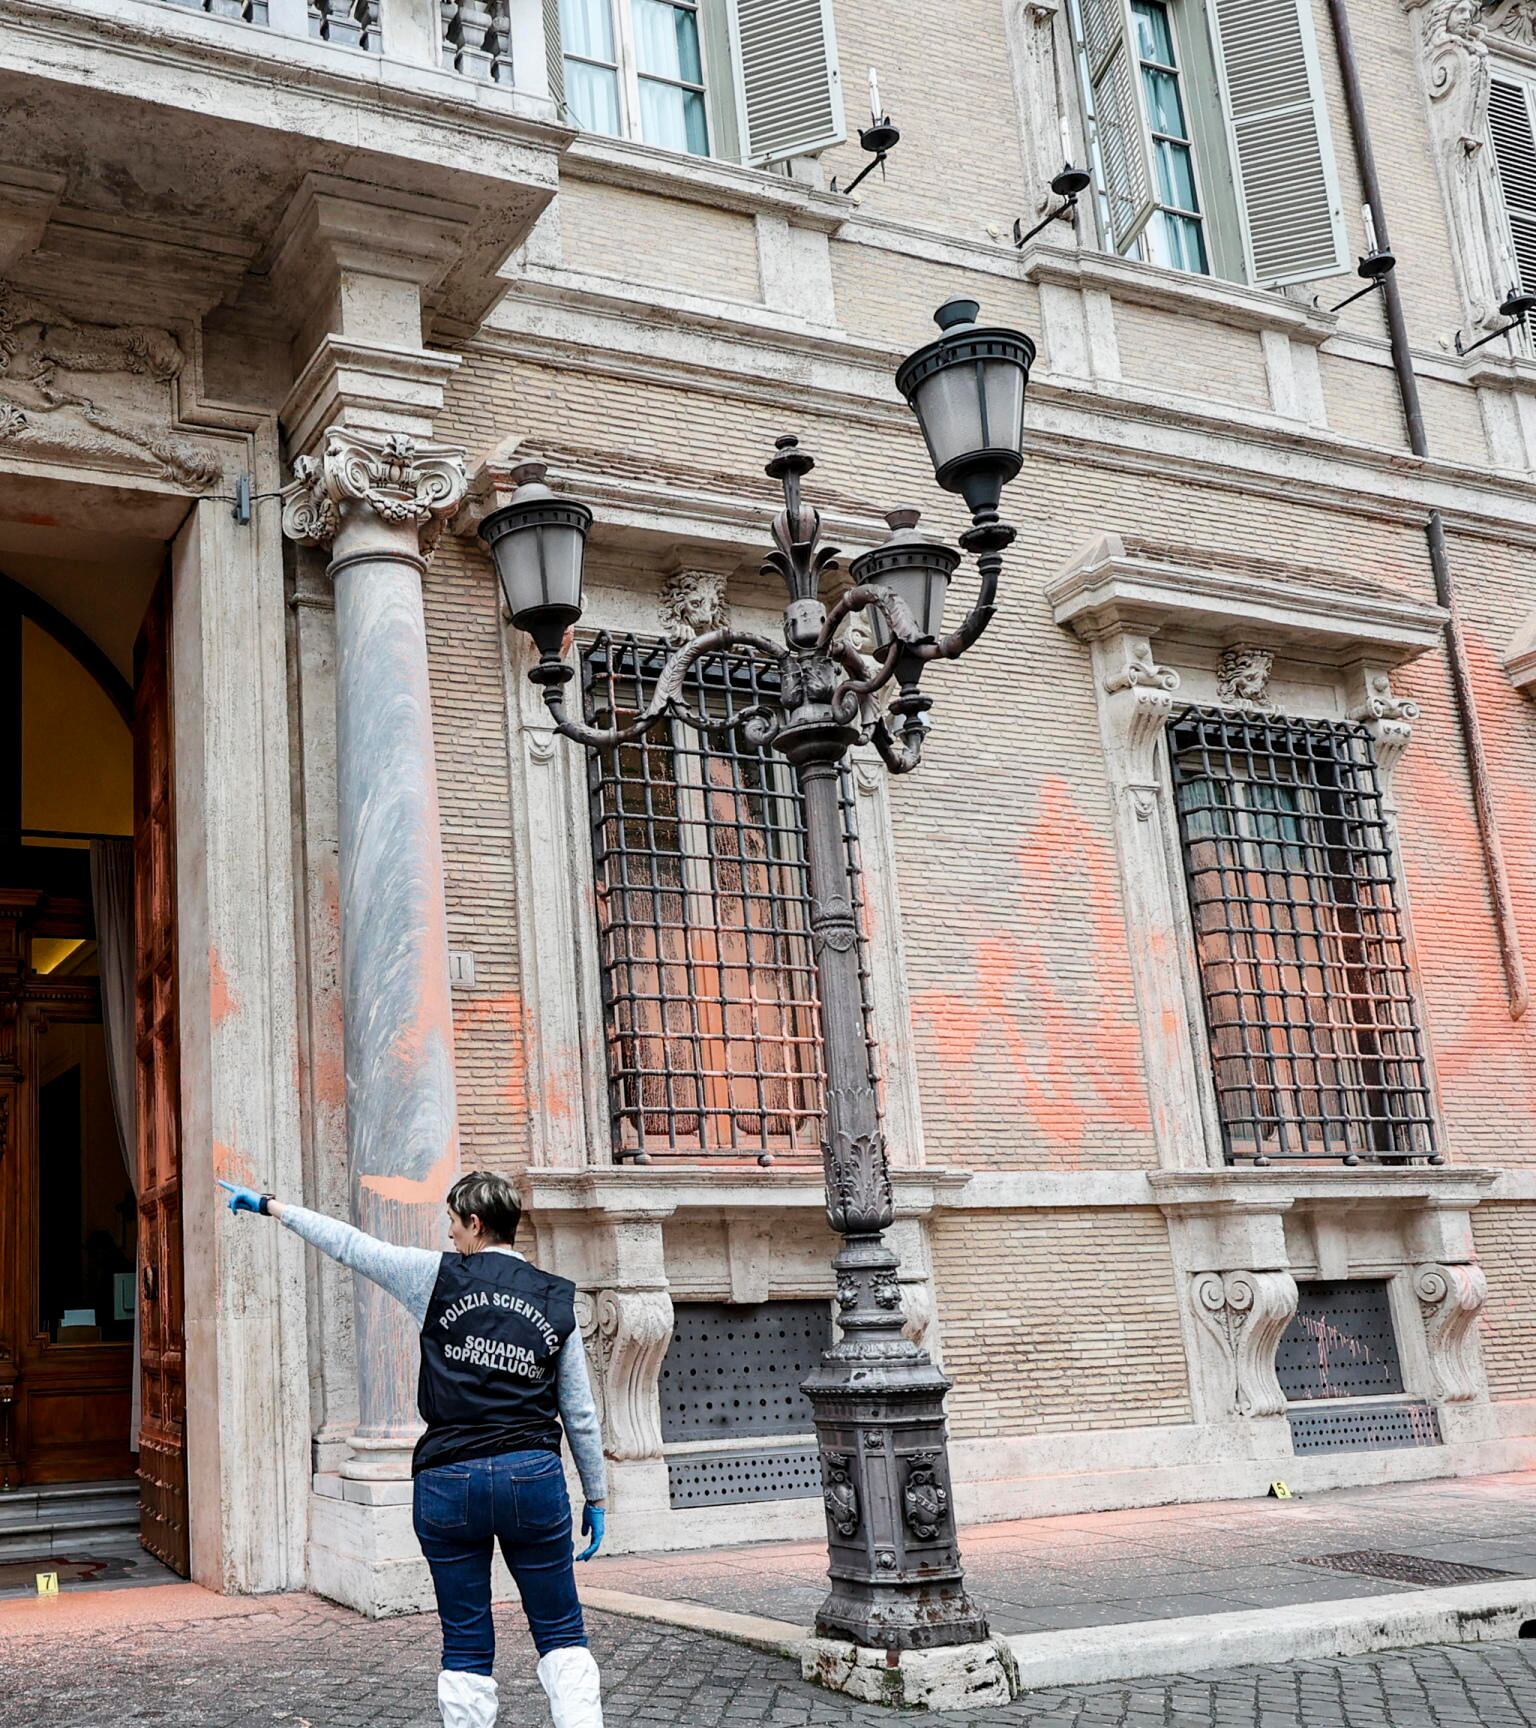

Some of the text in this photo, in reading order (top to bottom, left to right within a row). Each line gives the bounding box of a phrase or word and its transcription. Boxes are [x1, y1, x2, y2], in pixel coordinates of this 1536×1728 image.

[439, 1291, 560, 1355] POLIZIA SCIENTIFICA
[465, 1335, 535, 1364] SQUADRA
[1276, 1482, 1286, 1496] 5
[43, 1574, 51, 1590] 7
